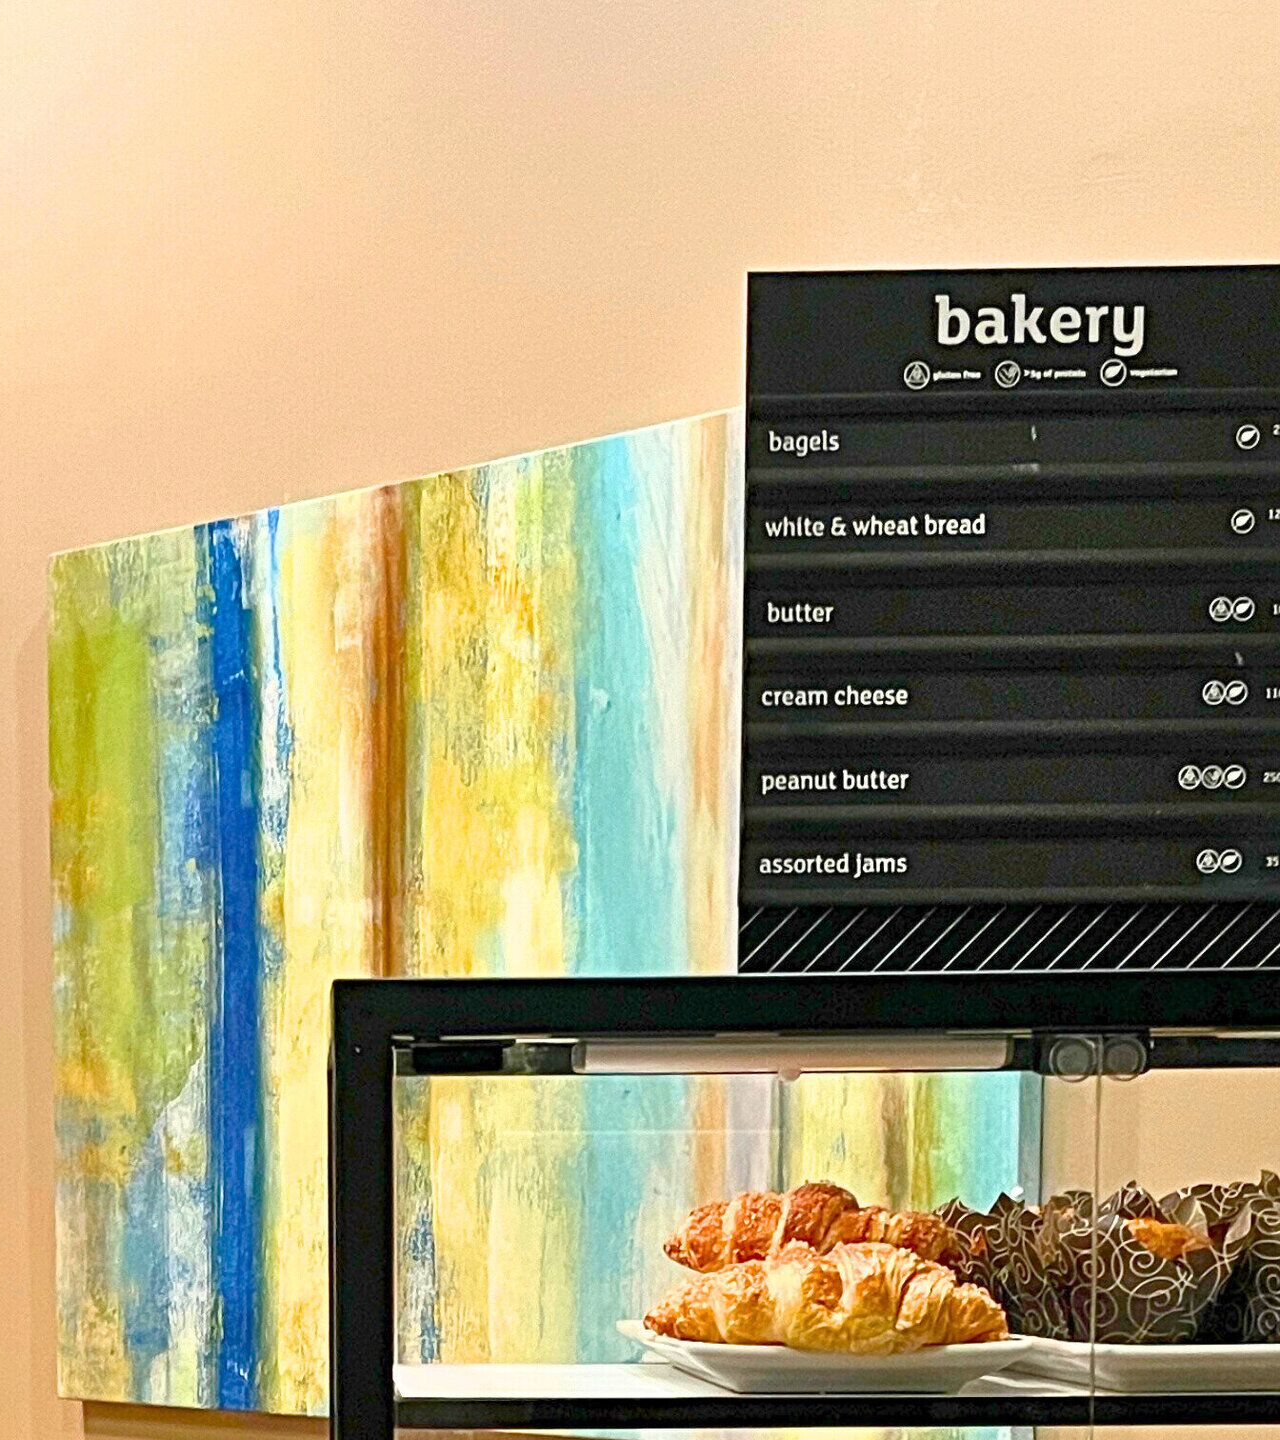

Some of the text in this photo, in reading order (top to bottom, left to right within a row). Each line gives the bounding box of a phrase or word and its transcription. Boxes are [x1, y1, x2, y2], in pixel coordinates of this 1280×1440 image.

[935, 294, 1145, 357] bakery
[1054, 368, 1087, 380] protein
[1130, 368, 1179, 379] vegetarian
[768, 429, 840, 458] bagels
[765, 513, 986, 538] white & wheat bread
[767, 602, 835, 623] butter
[761, 685, 909, 707] cream cheese
[761, 769, 910, 795] peanut butter
[759, 853, 908, 879] assorted jams
[1266, 856, 1280, 868] 35
